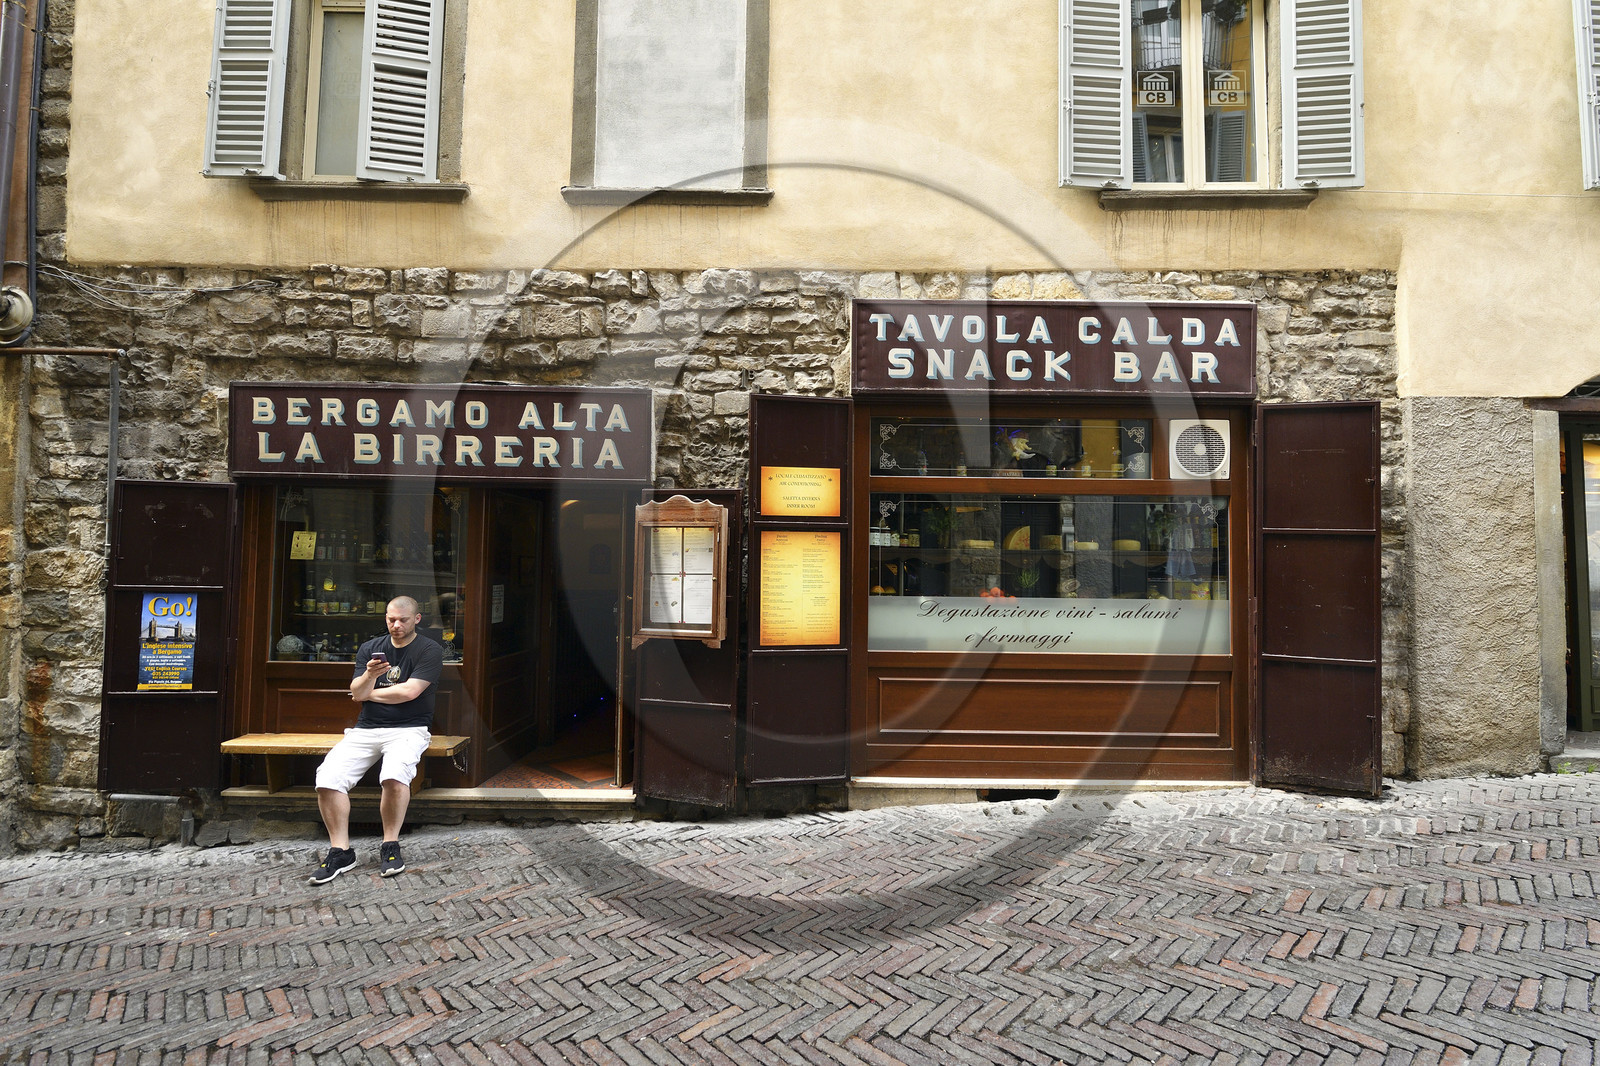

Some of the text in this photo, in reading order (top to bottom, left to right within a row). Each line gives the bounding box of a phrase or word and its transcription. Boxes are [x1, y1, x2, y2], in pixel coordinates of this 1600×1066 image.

[1145, 91, 1167, 103] CB
[1217, 91, 1238, 103] CB
[869, 313, 1241, 347] TAVOLA CALDA
[888, 348, 1221, 384] SNACK BAR
[252, 396, 631, 433] BERGAMO ALTA
[257, 431, 624, 470] LA BIRRERIA
[148, 596, 193, 617] Go!
[916, 599, 1051, 623] Degustazione
[1055, 606, 1097, 619] vini
[1112, 603, 1182, 620] salumi
[964, 626, 1075, 649] e formaggi
